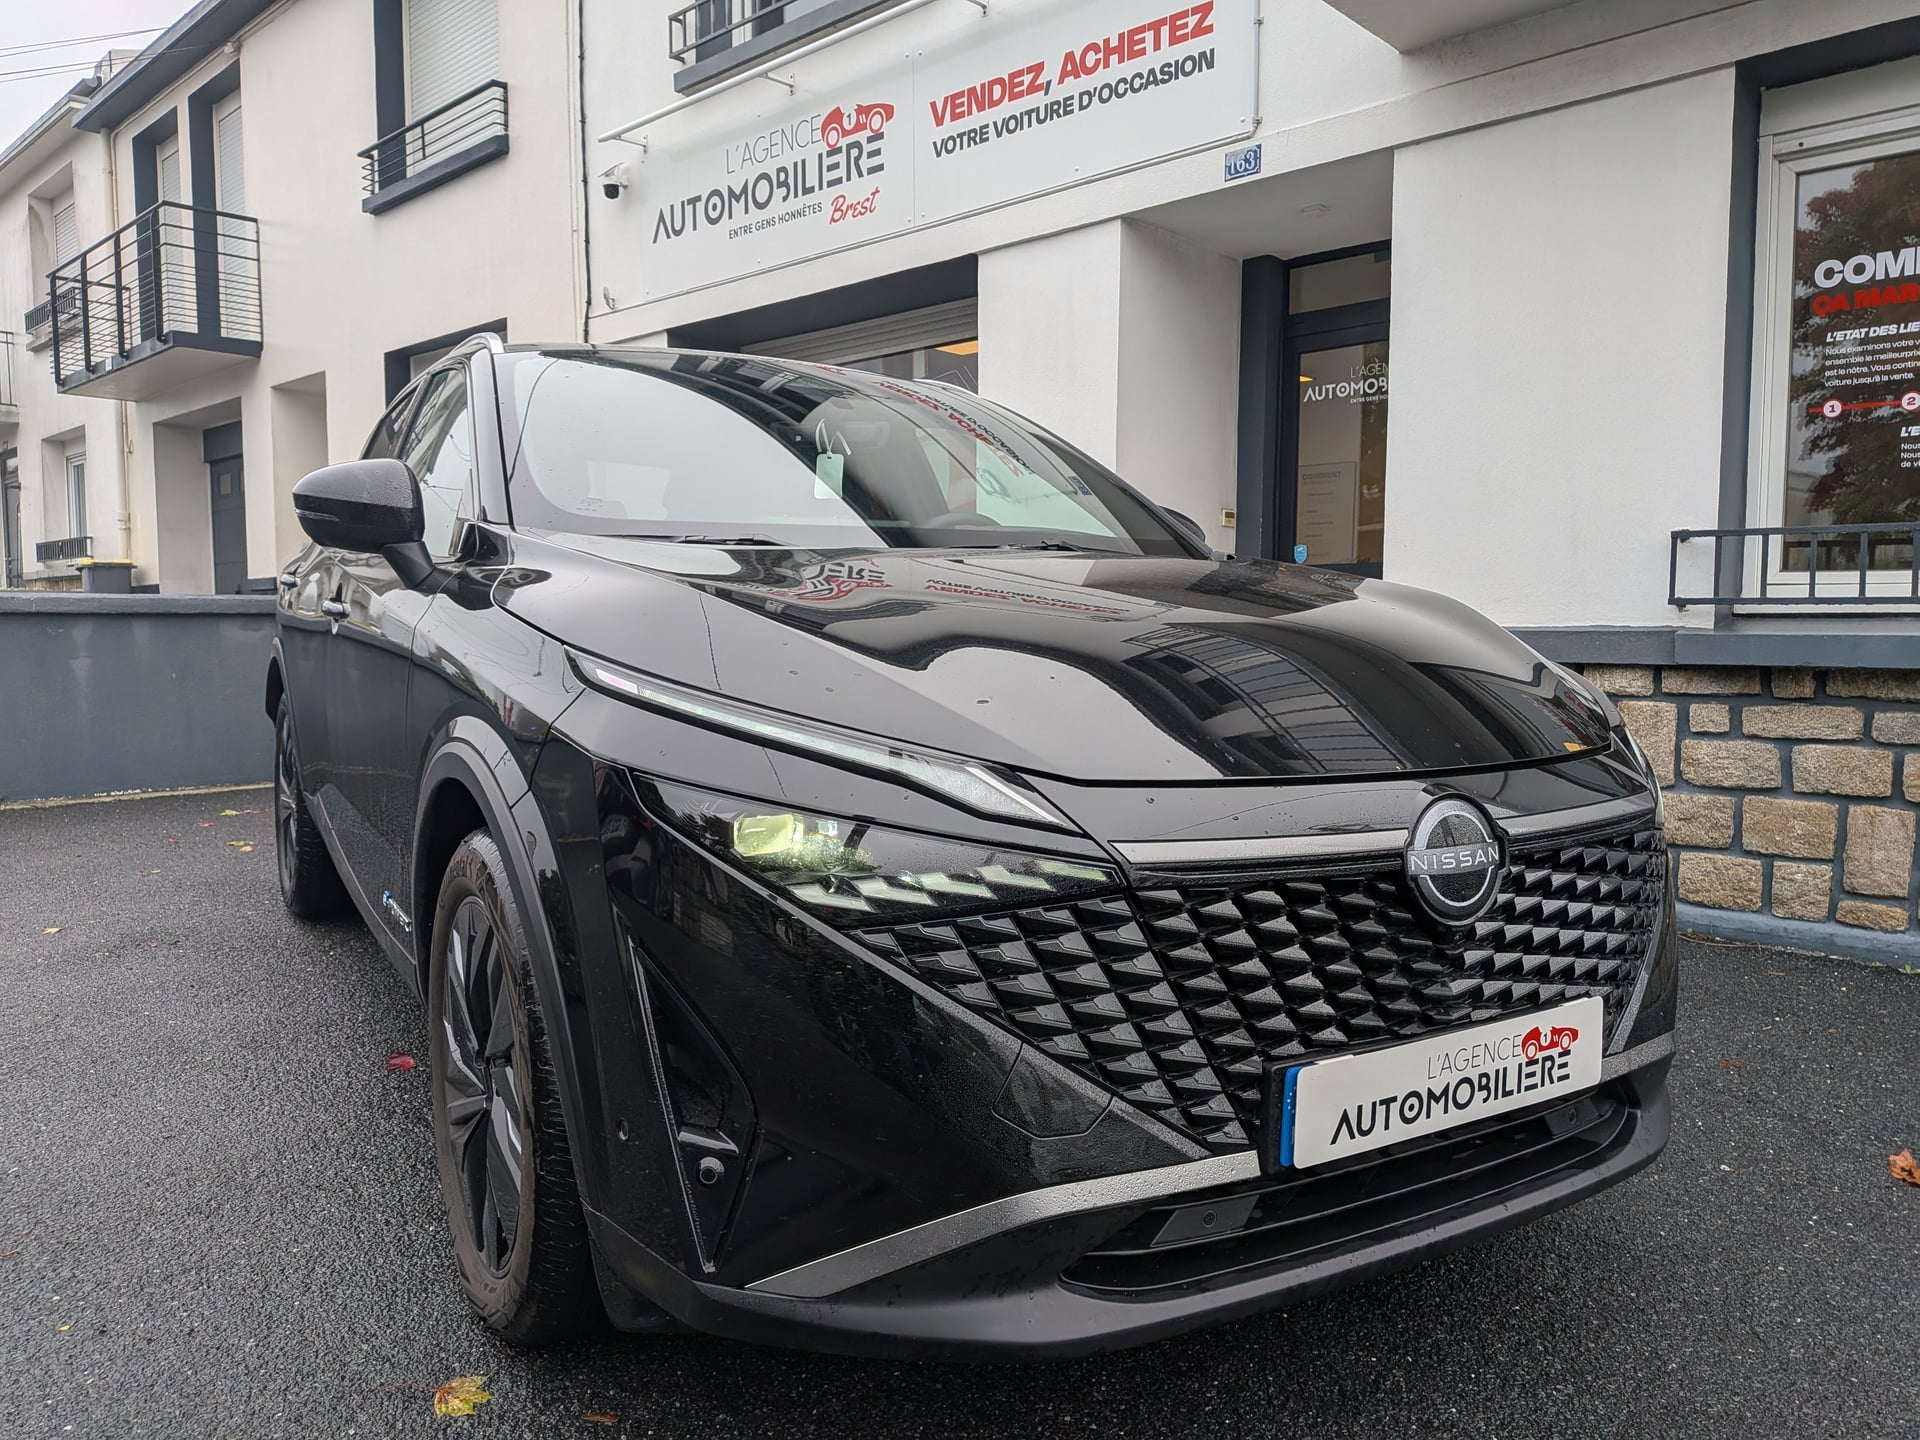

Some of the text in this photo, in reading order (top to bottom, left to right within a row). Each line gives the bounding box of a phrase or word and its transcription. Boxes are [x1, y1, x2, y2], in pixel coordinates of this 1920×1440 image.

[930, 0, 1214, 128] VENDEZ, ACHETEZ
[932, 48, 1215, 158] VOTRE VOITURE D'OCCASION
[726, 114, 822, 174] L'AGENCE
[1230, 151, 1255, 174] 163
[828, 186, 881, 225] Brest
[728, 202, 823, 240] ENTRE GENS HONNÊTES
[1812, 283, 1920, 318] ÇA MAR
[1825, 347, 1846, 356] Nous
[1847, 342, 1891, 353] examinons
[1892, 339, 1914, 348] votre
[1826, 327, 1869, 342] L'ETAT
[1868, 324, 1898, 337] DES
[1825, 356, 1864, 366] ensemble
[1865, 354, 1873, 362] le
[1825, 368, 1838, 377] est
[1870, 363, 1891, 372] Vous
[1824, 378, 1852, 387] voiture
[1889, 372, 1915, 381] vente.
[1410, 845, 1499, 871] NISSAN
[1427, 1034, 1522, 1080] L'AGENCE
